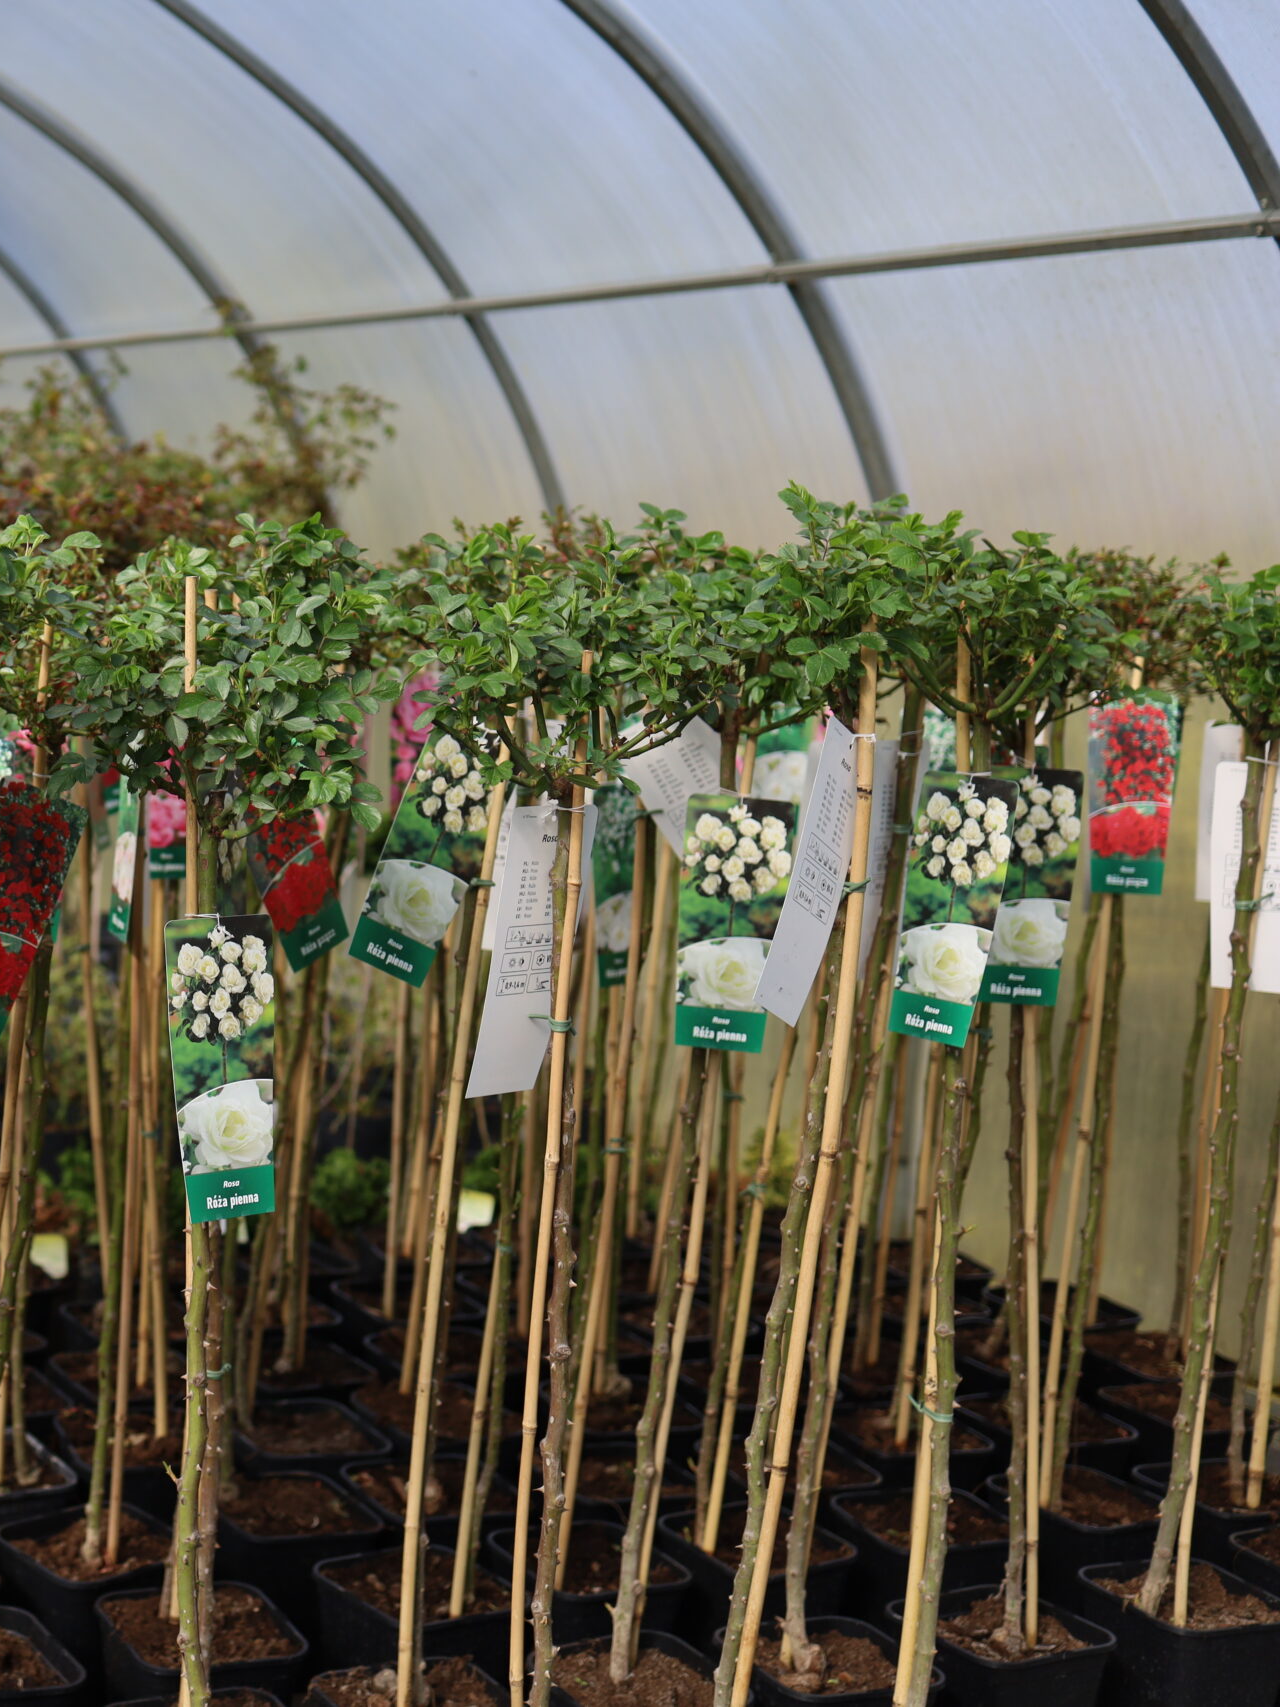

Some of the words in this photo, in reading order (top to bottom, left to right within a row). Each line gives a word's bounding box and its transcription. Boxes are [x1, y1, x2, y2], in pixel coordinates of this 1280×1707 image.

[366, 941, 387, 960] Róża
[385, 953, 414, 973] pienna
[990, 982, 1011, 995] Róża
[1012, 983, 1042, 998] pienna
[905, 1013, 925, 1028] Róża
[924, 1018, 954, 1035] pienna
[692, 1025, 715, 1040] Róża
[715, 1029, 747, 1043] pienna
[223, 1180, 240, 1189] Rosa
[206, 1194, 228, 1210] Róża
[229, 1193, 259, 1210] pienna
